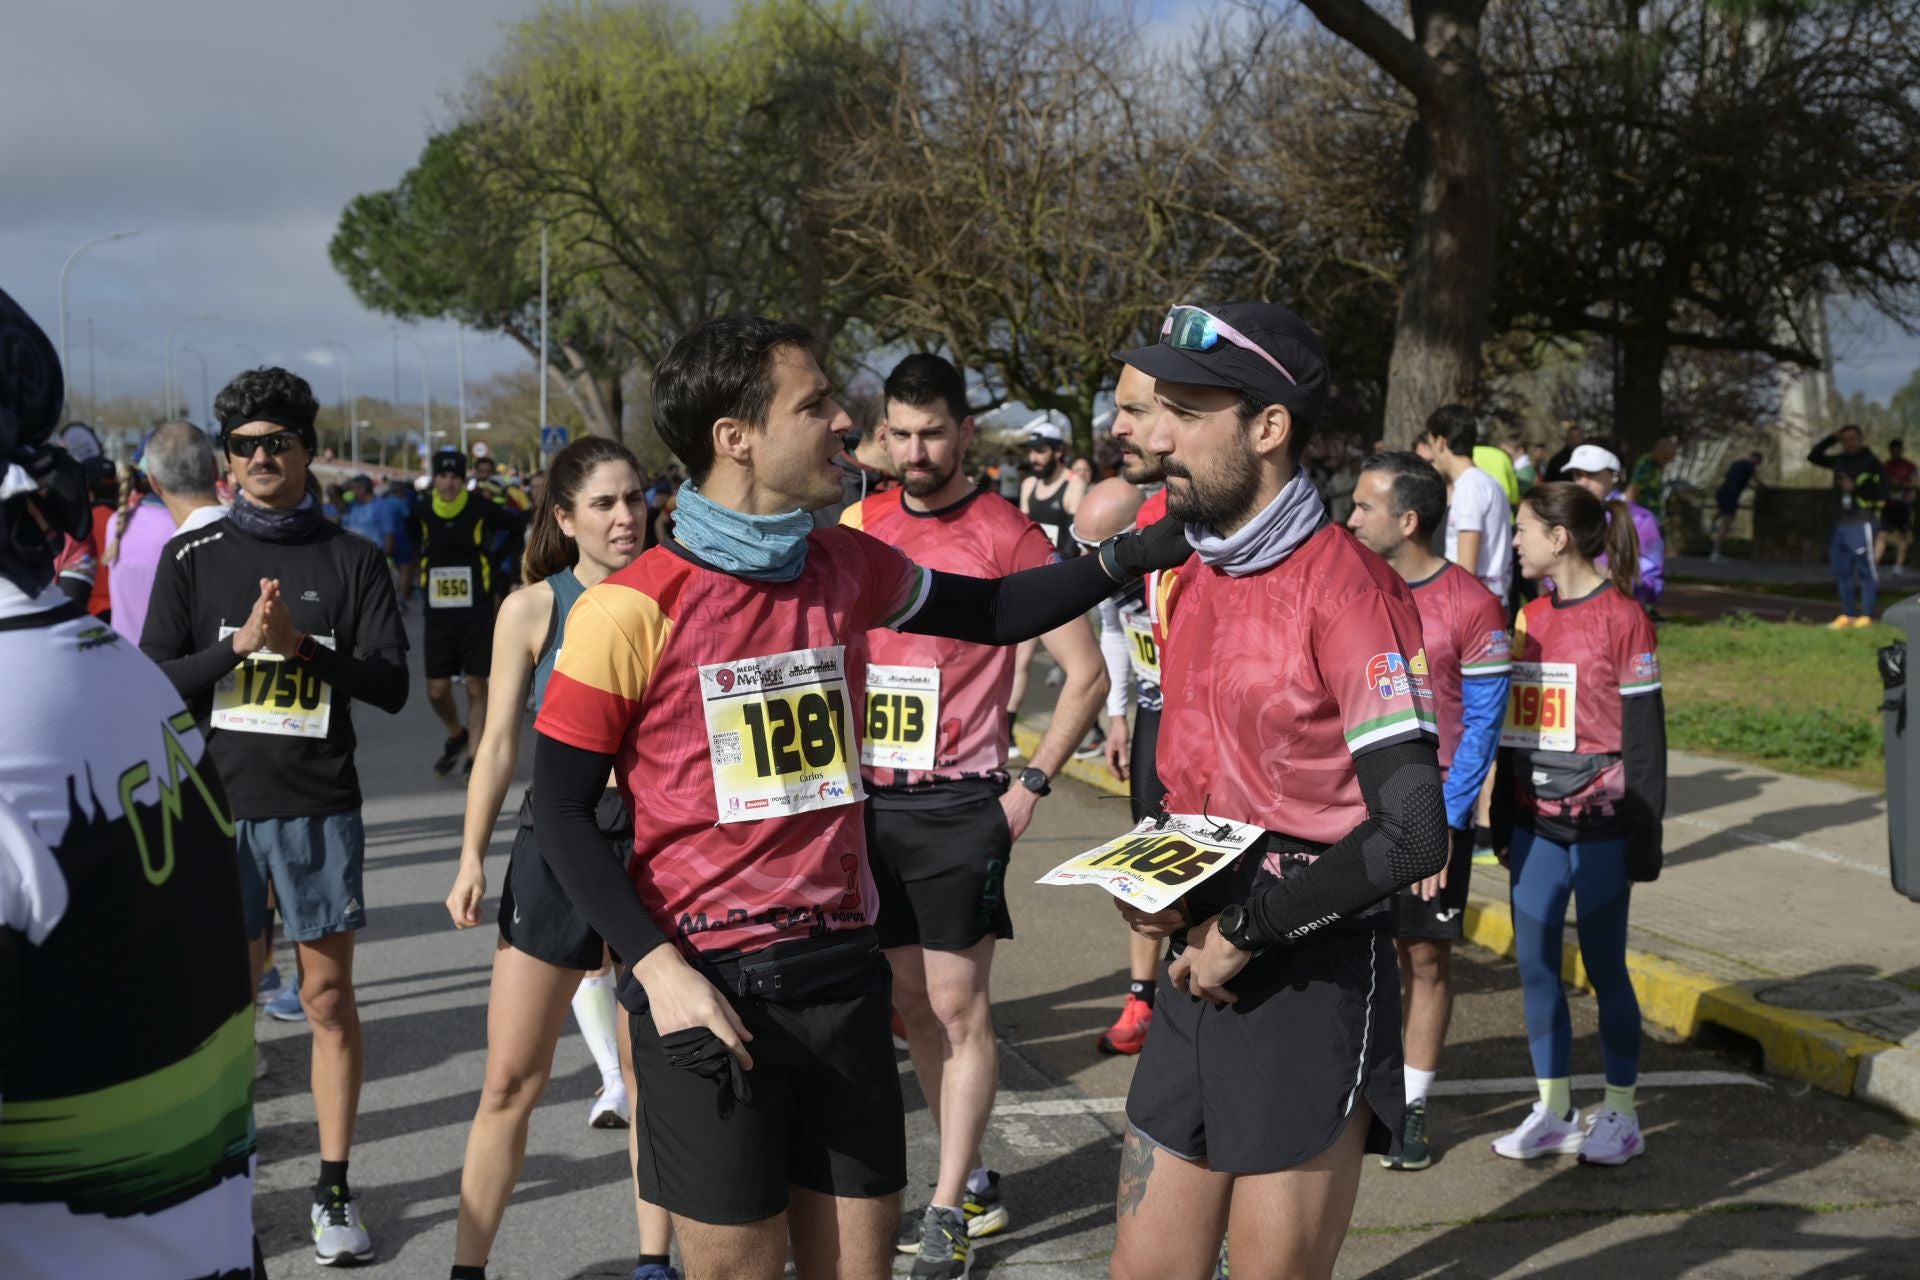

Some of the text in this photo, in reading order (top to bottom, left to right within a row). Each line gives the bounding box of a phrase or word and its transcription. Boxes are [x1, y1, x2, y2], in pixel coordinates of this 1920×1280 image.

[436, 579, 468, 598] 1650
[242, 659, 322, 711] 1750
[716, 668, 735, 693] 9
[1512, 686, 1566, 729] 1961
[743, 689, 847, 778] 1281
[799, 771, 824, 783] Carlos
[1088, 835, 1226, 886] 1405
[1285, 912, 1341, 939] KIPRUN
